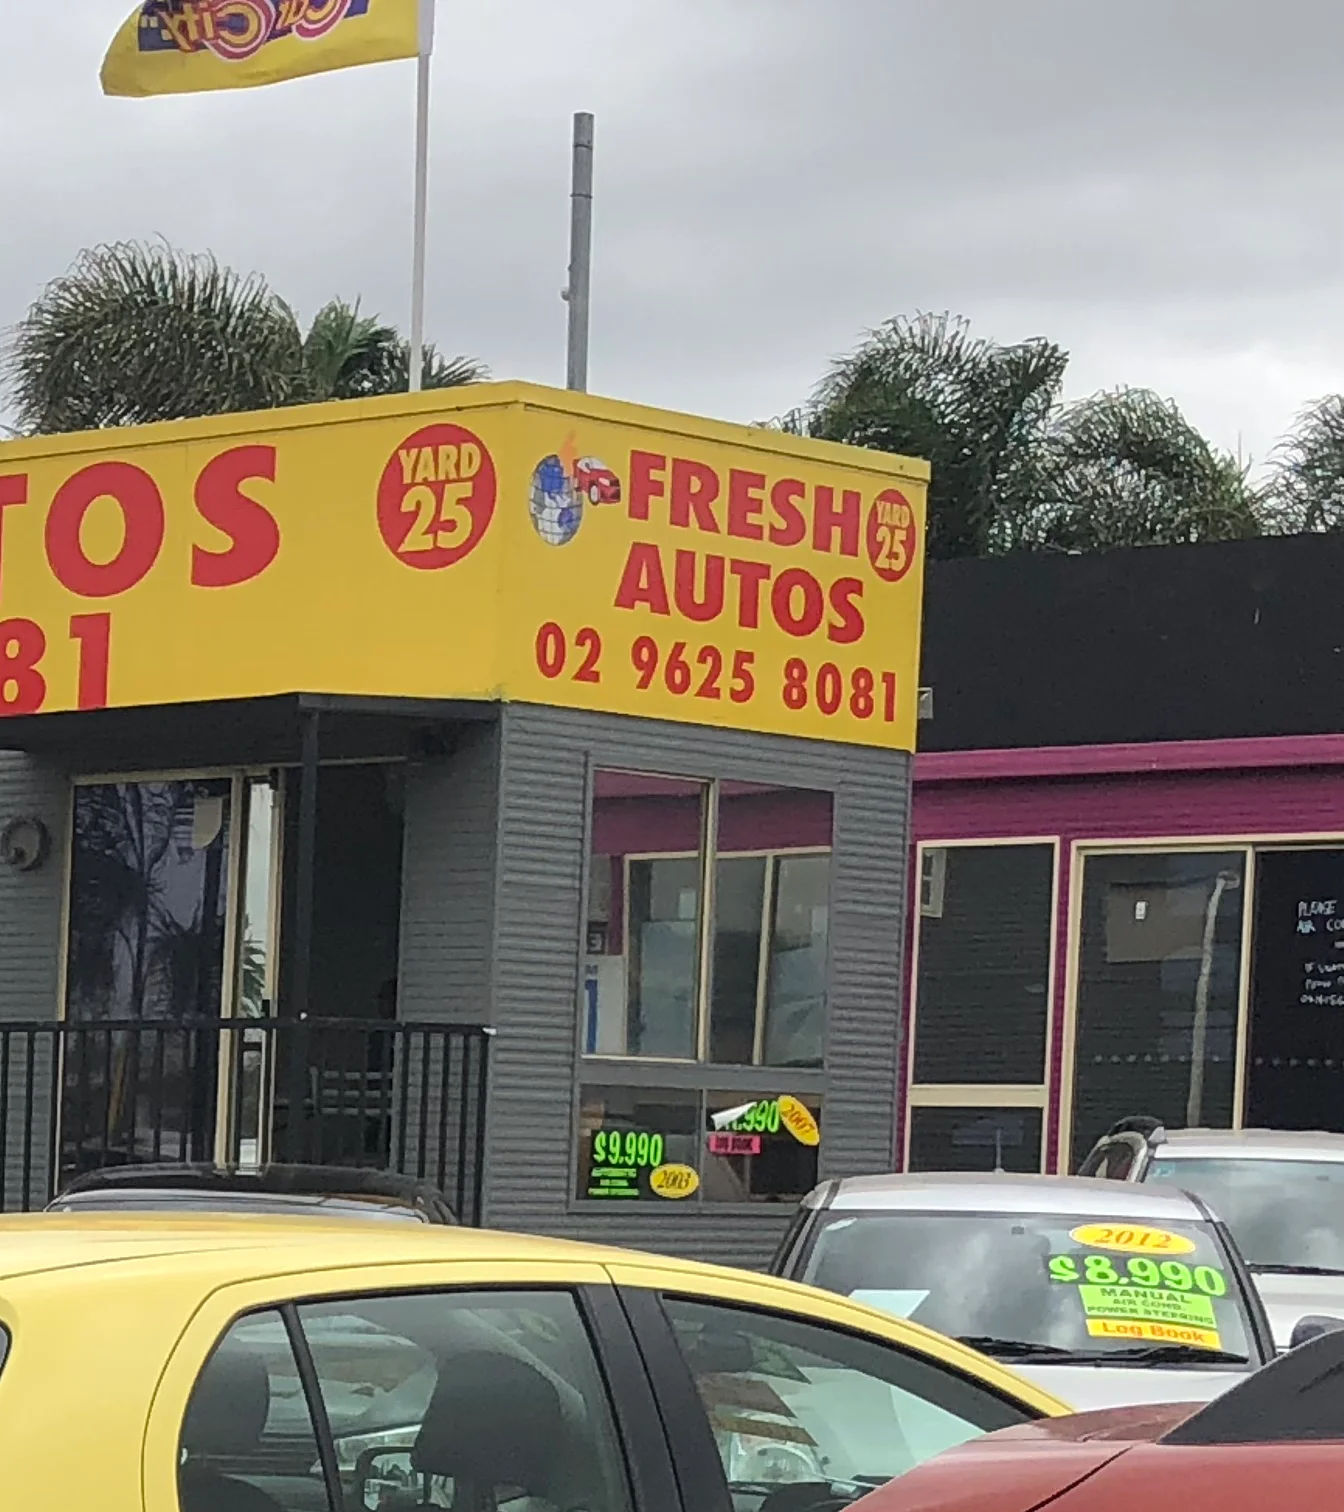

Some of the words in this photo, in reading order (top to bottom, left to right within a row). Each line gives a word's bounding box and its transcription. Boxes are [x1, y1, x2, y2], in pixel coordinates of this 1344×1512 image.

[398, 442, 480, 484] YARD
[396, 481, 474, 553] 25
[627, 449, 862, 558] FRESH
[875, 498, 910, 528] YARD
[874, 528, 908, 571] 25
[613, 541, 866, 645] AUTOS
[535, 621, 602, 683] 02
[630, 635, 755, 704] 9625
[781, 656, 897, 723] 8081
[592, 1130, 664, 1167] $9.990
[1094, 1228, 1173, 1249] 2012
[1048, 1254, 1227, 1297] $8.990
[1087, 1305, 1140, 1315] POWER
[1143, 1308, 1215, 1325] STEERING
[1099, 1287, 1193, 1305] MANUAL
[1112, 1298, 1137, 1307] AIR
[1101, 1321, 1143, 1338] Log
[1150, 1324, 1206, 1342] Book
